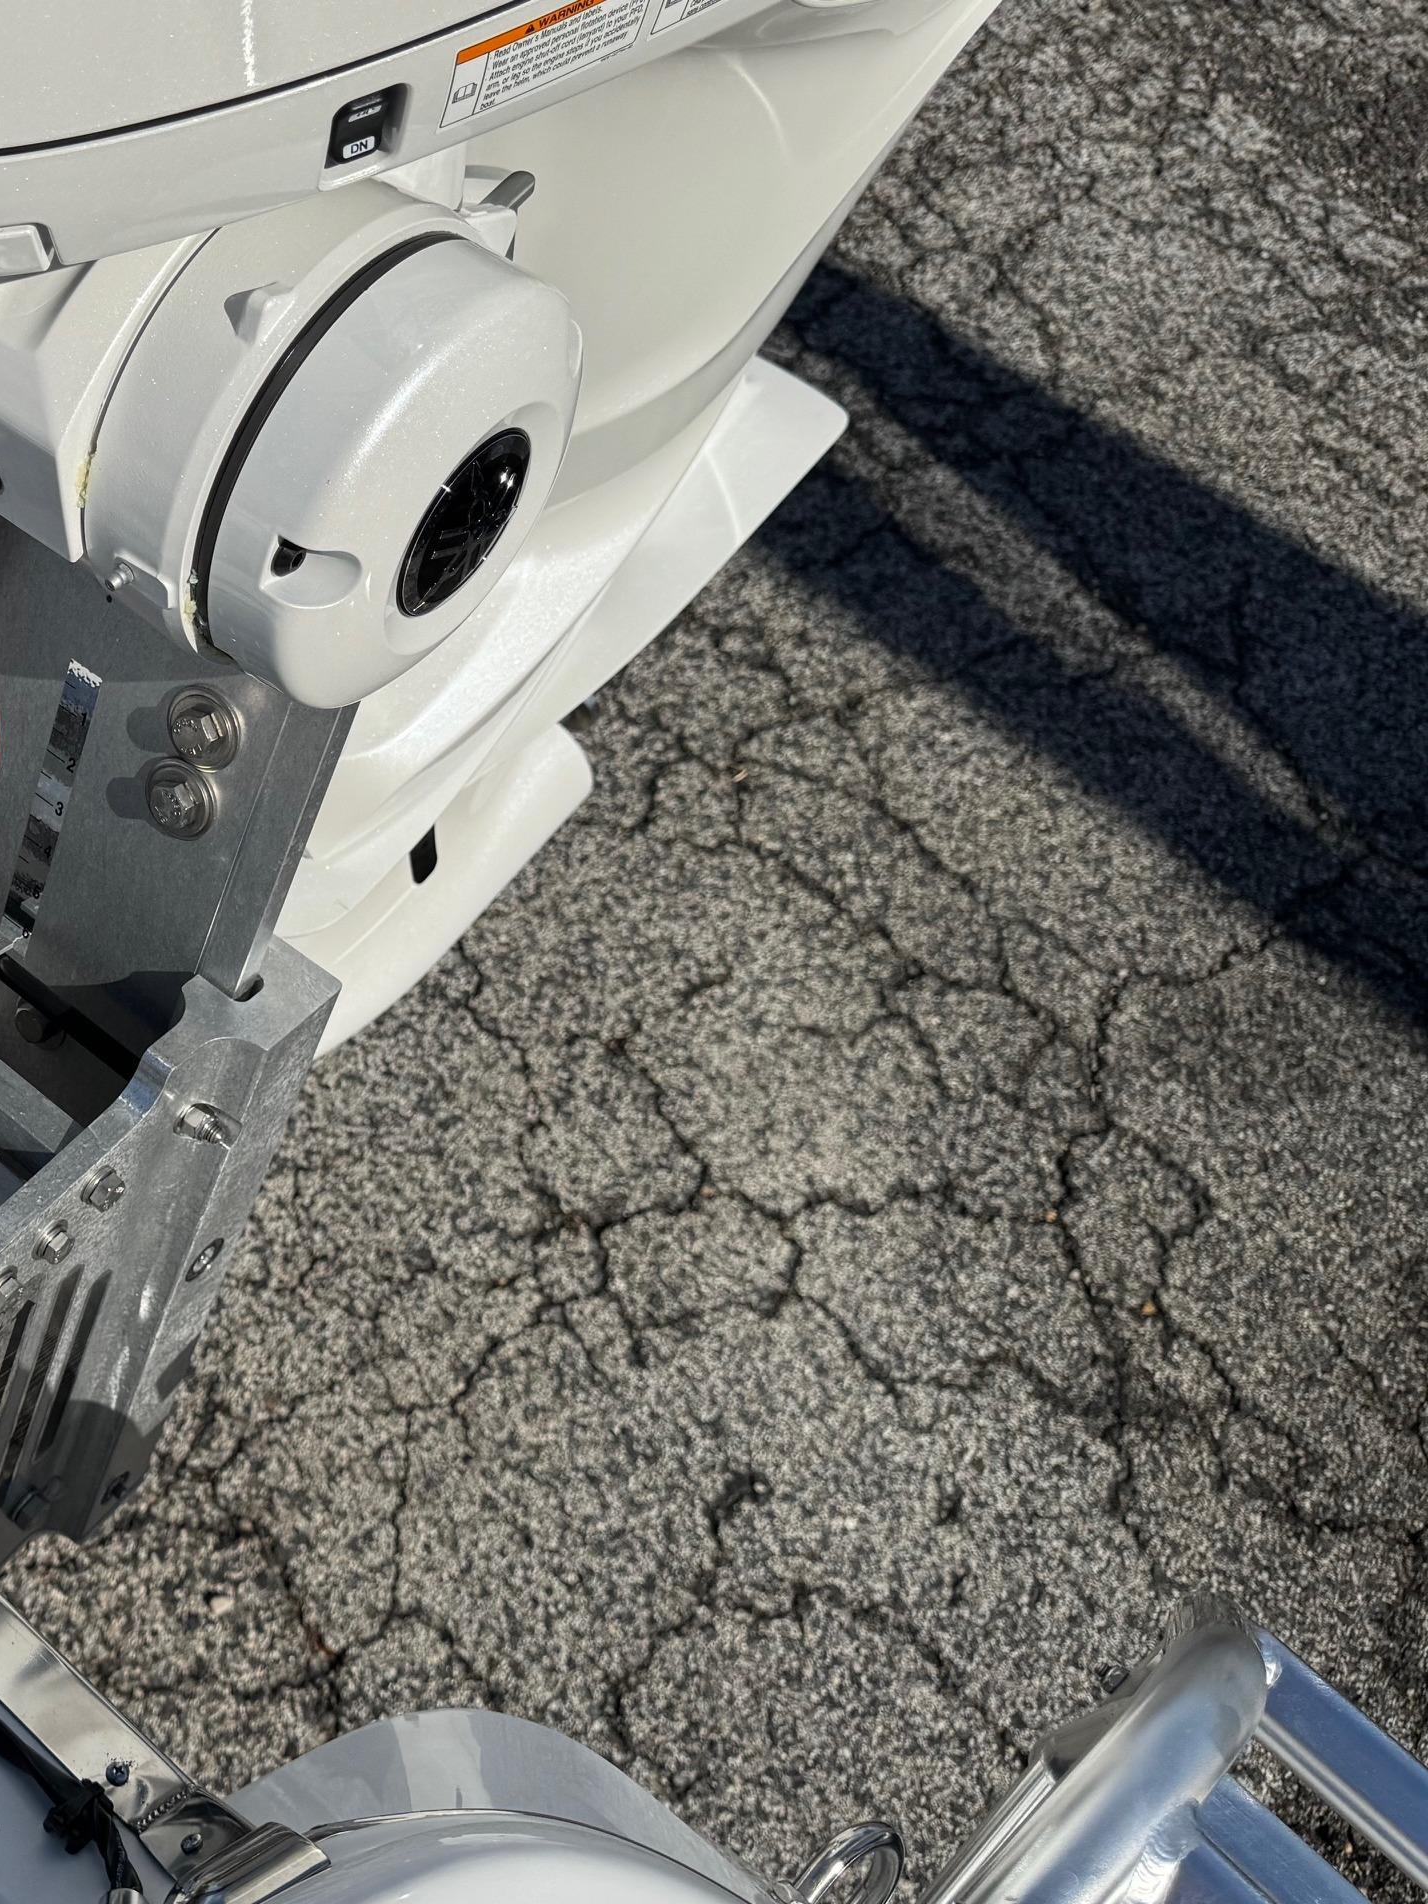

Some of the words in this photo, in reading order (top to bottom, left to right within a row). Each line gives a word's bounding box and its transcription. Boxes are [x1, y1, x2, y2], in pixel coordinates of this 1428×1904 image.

[540, 0, 593, 27] WARNING
[350, 139, 368, 155] DN
[66, 758, 76, 774] 2
[54, 801, 64, 817] 3
